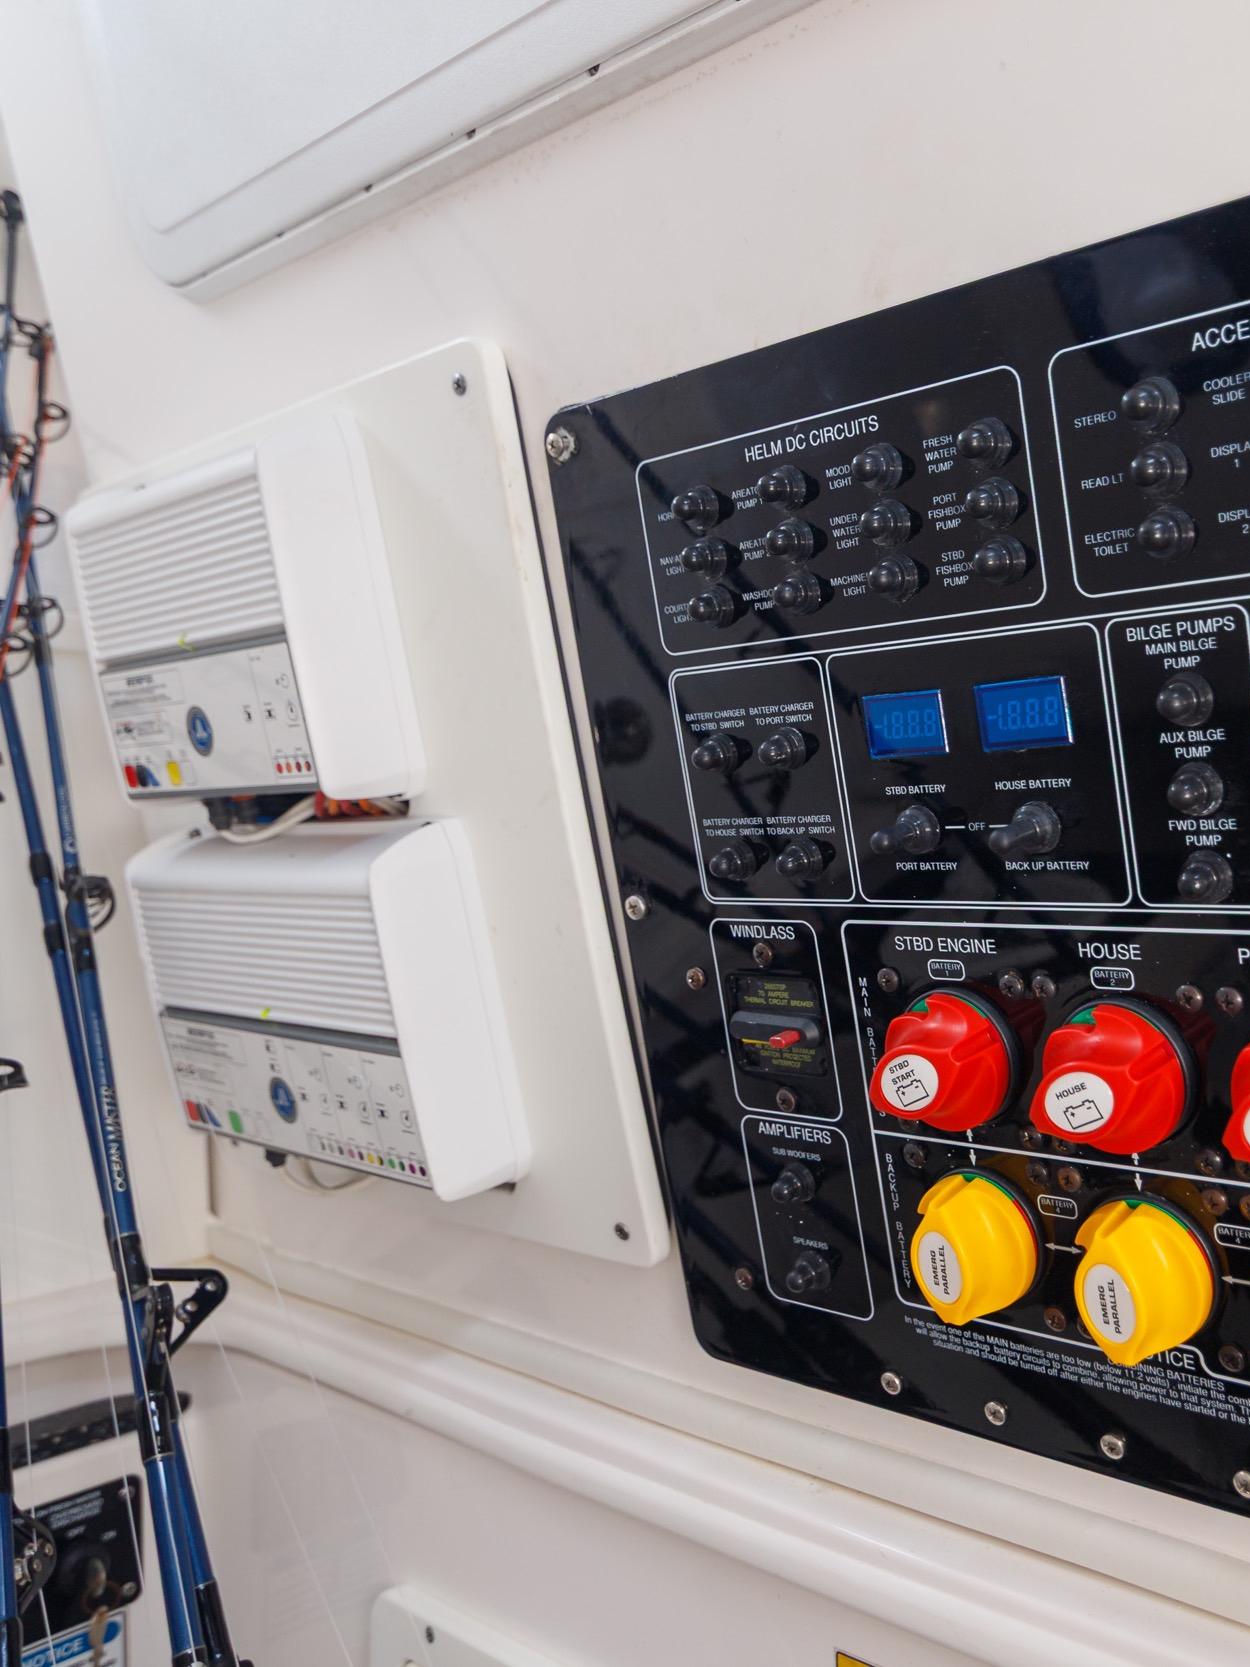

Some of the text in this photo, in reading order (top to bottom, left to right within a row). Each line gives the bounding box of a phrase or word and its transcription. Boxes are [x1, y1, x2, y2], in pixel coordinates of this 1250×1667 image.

[1212, 388, 1247, 405] SLIDE
[1074, 410, 1117, 428] STEREO
[743, 415, 879, 463] HELM DC CIRCUITS
[923, 434, 953, 449] FRESH
[925, 447, 957, 462] WATER
[928, 460, 954, 474] PUMP
[1234, 458, 1240, 468] 1
[825, 464, 850, 478] MOOD
[829, 476, 852, 490] LIGHT
[1080, 472, 1124, 491] READ LT
[736, 498, 758, 511] PUMP
[932, 492, 957, 506] PORT
[927, 504, 966, 520] FISHBOX
[829, 512, 858, 527] UNDER
[935, 518, 961, 532] PUMP
[832, 525, 862, 539] WATER
[1084, 527, 1135, 545] ELECTRIC
[1242, 524, 1249, 534] 2
[836, 537, 860, 550] LIGHT
[1092, 542, 1129, 557] TOILET
[743, 549, 769, 561] PUMP
[941, 550, 965, 562] STBD
[935, 561, 974, 576] FISHBOX
[943, 575, 969, 588] PUMP
[843, 585, 867, 597] LIGHT
[1126, 615, 1236, 642] BILGE PUMPS
[1145, 636, 1218, 656] MAIN BILGE
[1163, 655, 1200, 670] PUMP
[685, 708, 746, 722] BATTERY CHARGER
[749, 701, 814, 716] BATTERY CHARGER
[691, 719, 745, 731] TO STBD SWITCH
[755, 713, 812, 726] TO PORT SWITCH
[1159, 728, 1226, 744] AUX BILGE
[1175, 745, 1211, 759] PUMP
[885, 783, 946, 796] STBD BATTERY
[994, 777, 1072, 791] HOUSE BATTERY
[702, 817, 763, 827] BATTERY CHARGER
[766, 814, 831, 825] BATTERY CHARGER
[1168, 818, 1238, 831] FWD BILGE
[715, 828, 738, 837] HOUSE
[739, 827, 765, 836] SWITCH
[808, 825, 836, 834] SWITCH
[968, 822, 986, 832] OFF
[1185, 834, 1222, 847] PUMP
[896, 861, 958, 871] PORT BATTERY
[1005, 860, 1090, 871] BACK UP BATTERY
[729, 924, 796, 941] WINDLASS
[894, 935, 997, 955] STBD ENGINE
[1078, 942, 1142, 961] HOUSE
[931, 962, 961, 971] BATTERY
[1094, 969, 1130, 980] BATTERY
[858, 977, 872, 1017] MAIN
[889, 1059, 910, 1075] STBD
[891, 1069, 916, 1086] START
[1055, 1082, 1088, 1101] HOUSE
[758, 1121, 832, 1145] AMPLIFIERS
[772, 1147, 822, 1162] SUB WOOFERS
[1041, 1198, 1075, 1210] BATTERY
[885, 1153, 912, 1289] BACKUP BATTERY
[792, 1235, 829, 1251] SPEAKERS
[930, 1249, 940, 1286] EMERG
[939, 1244, 952, 1295] PARALLEL
[1097, 1285, 1110, 1325] EMERG
[1107, 1279, 1122, 1334] PARALLEL
[1167, 1370, 1225, 1391] BATTERIES
